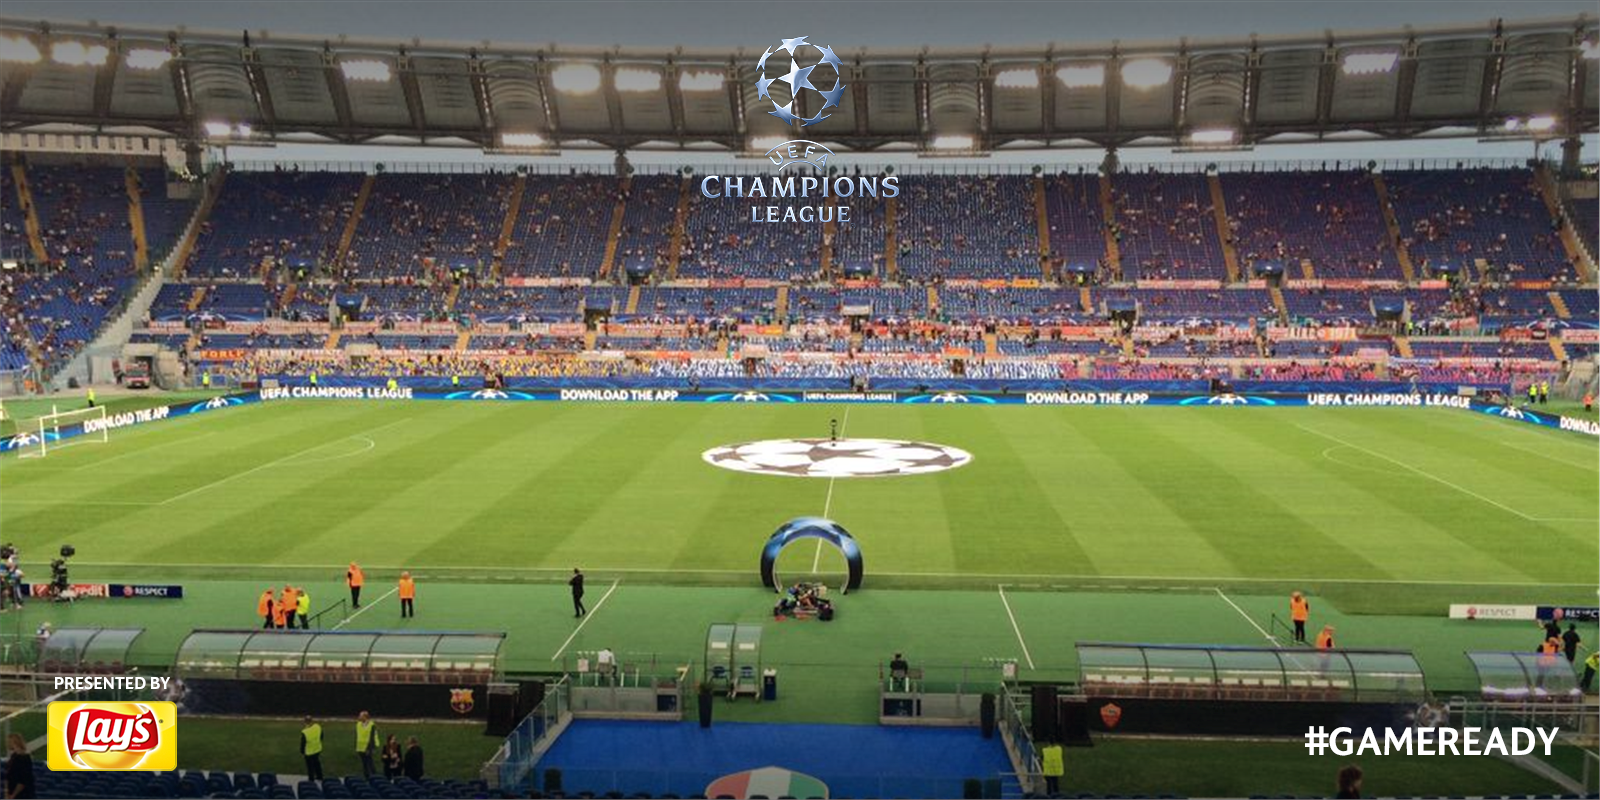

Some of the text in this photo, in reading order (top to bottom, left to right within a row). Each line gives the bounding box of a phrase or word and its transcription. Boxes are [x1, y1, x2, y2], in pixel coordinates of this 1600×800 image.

[260, 387, 413, 399] UEFA CHAMPIONS LEAGUE
[561, 389, 678, 400] DOWNLOAD THE APP
[807, 392, 892, 400] UEFA CHAMPIONS LEAGUE
[1026, 392, 1149, 403] DOWNLOAD THE APP
[1307, 393, 1471, 408] UEFA CHAMPIONS LEAGUE
[84, 406, 169, 433] DOWNLOAD THE APP
[1560, 416, 1599, 435] DOWNLO
[134, 587, 168, 596] RESPECT
[1479, 608, 1517, 617] RESPECT
